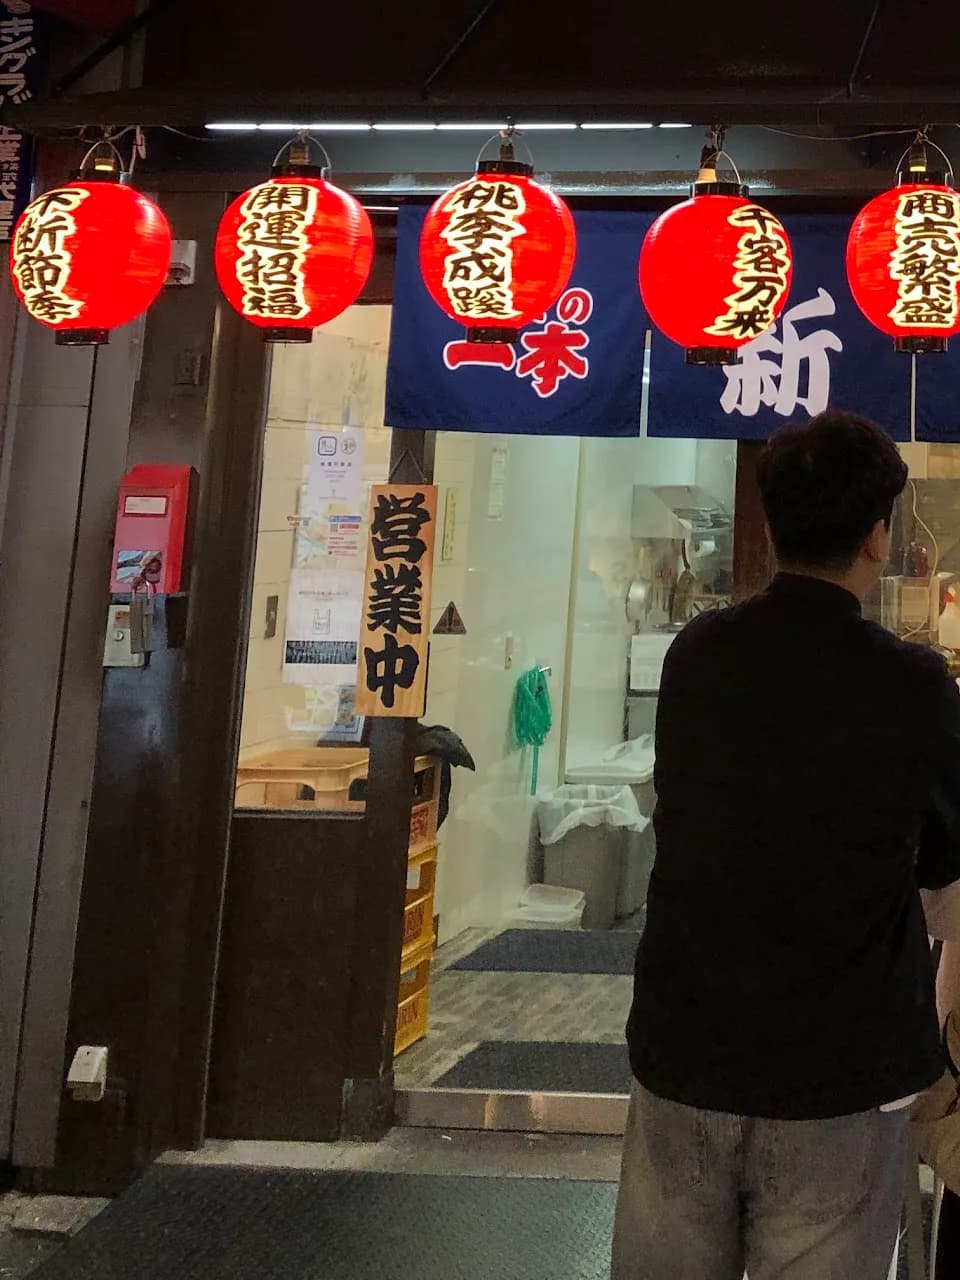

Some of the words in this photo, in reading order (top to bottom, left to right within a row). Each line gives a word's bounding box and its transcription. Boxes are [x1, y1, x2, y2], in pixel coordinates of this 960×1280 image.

[15, 190, 80, 321] 不断節季
[241, 186, 309, 317] 開運招福
[448, 184, 522, 317] 桃李成蹊
[720, 207, 786, 336] 千客万来
[891, 193, 960, 326] 商売繁盛
[362, 492, 434, 709] 営業中
